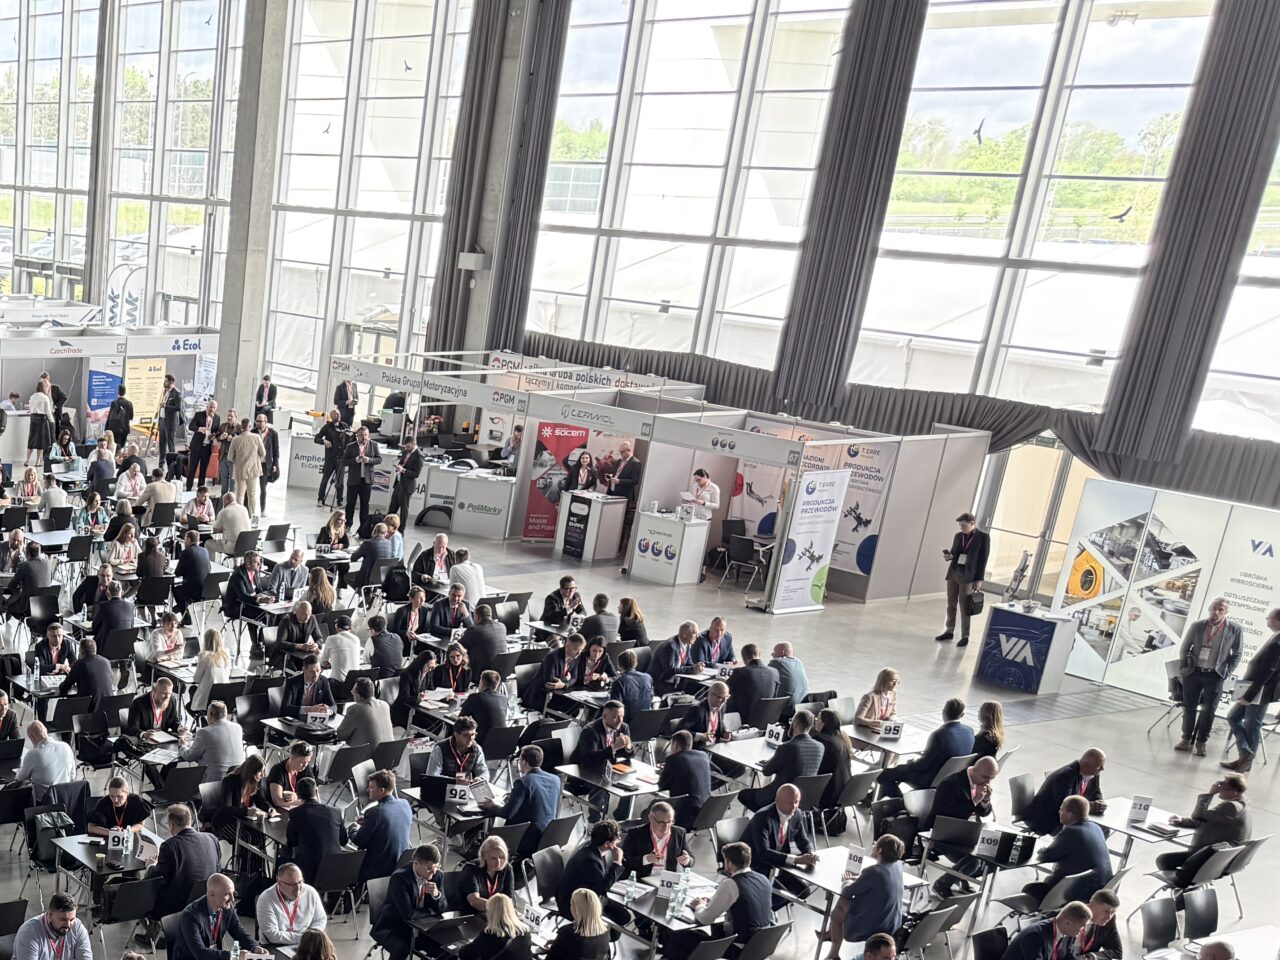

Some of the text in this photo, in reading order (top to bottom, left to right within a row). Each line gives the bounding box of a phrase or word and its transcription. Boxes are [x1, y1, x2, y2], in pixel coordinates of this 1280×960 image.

[183, 339, 201, 350] Ecol
[382, 372, 401, 385] Polska
[499, 392, 514, 405] PGM
[789, 454, 798, 464] 67
[850, 470, 884, 482] ZEWODÓW
[316, 544, 329, 554] 40
[311, 716, 326, 724] 77
[768, 728, 780, 742] 94
[884, 724, 900, 735] 95
[448, 788, 468, 800] 92
[980, 836, 998, 848] 109
[848, 854, 862, 864] 108
[524, 908, 540, 926] 106
